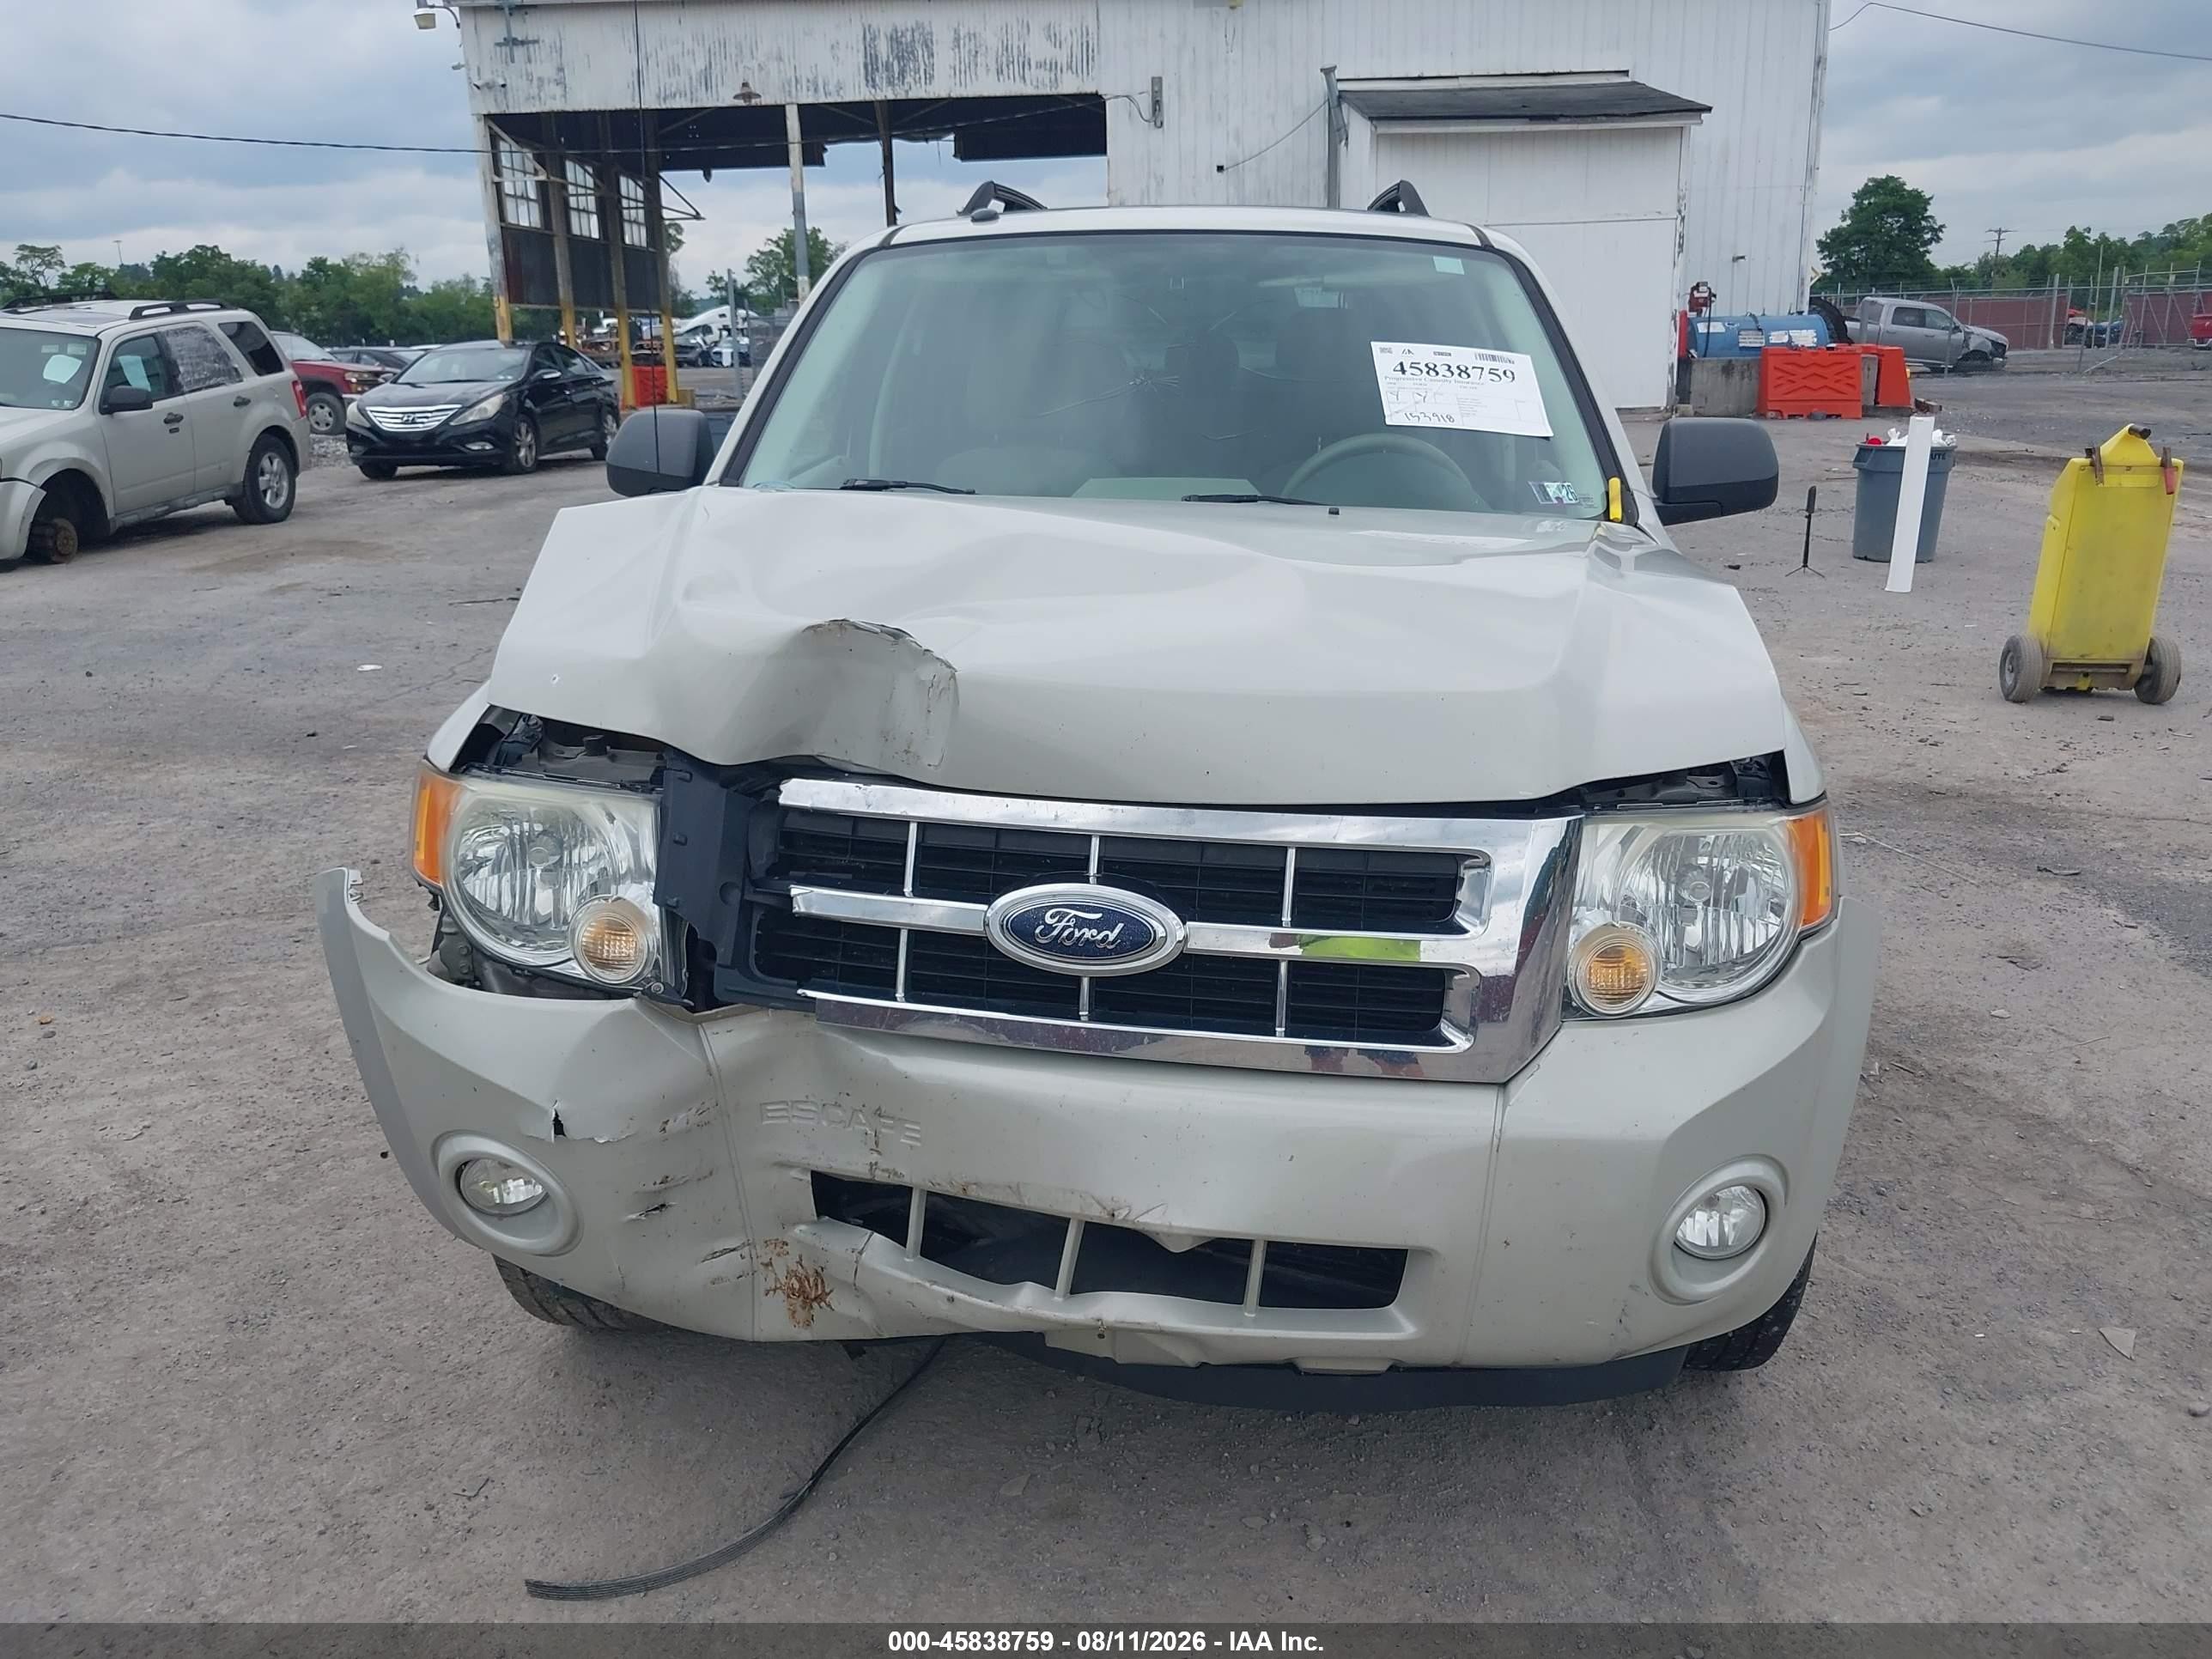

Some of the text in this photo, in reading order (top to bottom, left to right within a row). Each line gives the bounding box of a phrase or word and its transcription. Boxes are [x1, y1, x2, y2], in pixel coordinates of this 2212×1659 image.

[1392, 361, 1516, 384] 45838759
[1929, 452, 1947, 461] UTE
[1034, 908, 1126, 950] Ford
